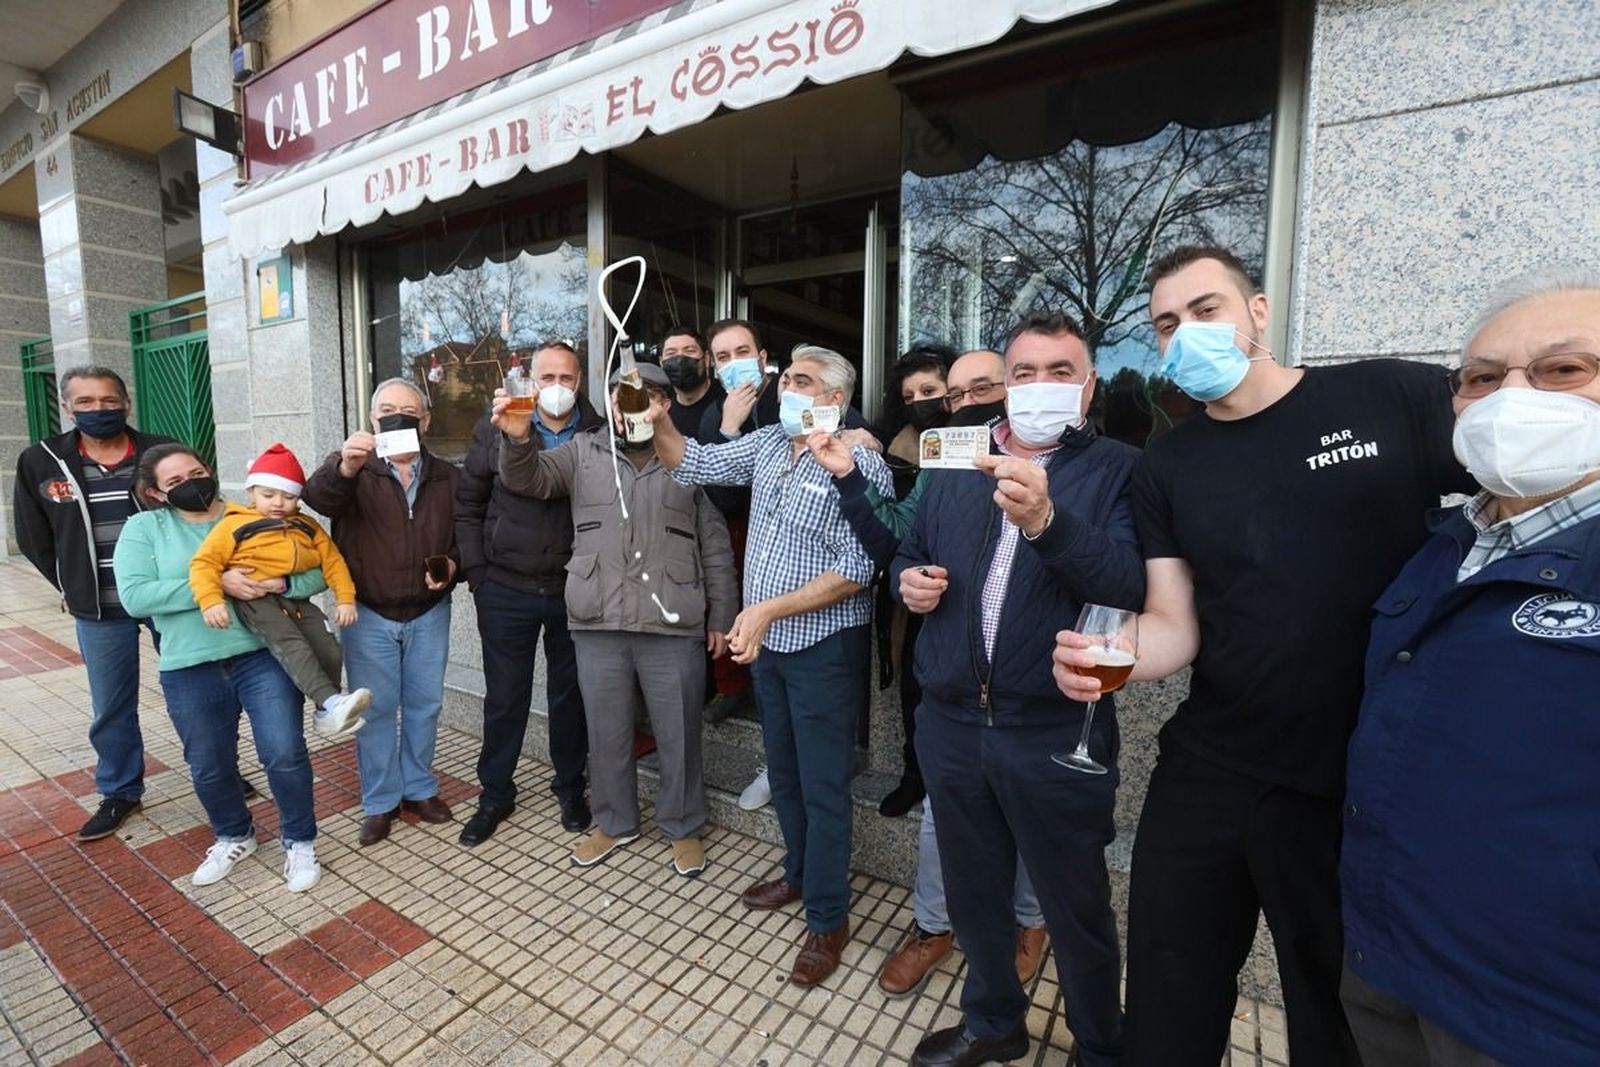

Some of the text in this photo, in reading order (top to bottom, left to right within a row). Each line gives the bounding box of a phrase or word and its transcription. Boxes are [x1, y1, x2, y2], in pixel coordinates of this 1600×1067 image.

[606, 75, 656, 127] EL
[41, 110, 59, 142] SAN
[1320, 429, 1353, 447] BAR
[1305, 439, 1379, 470] TRITÓN
